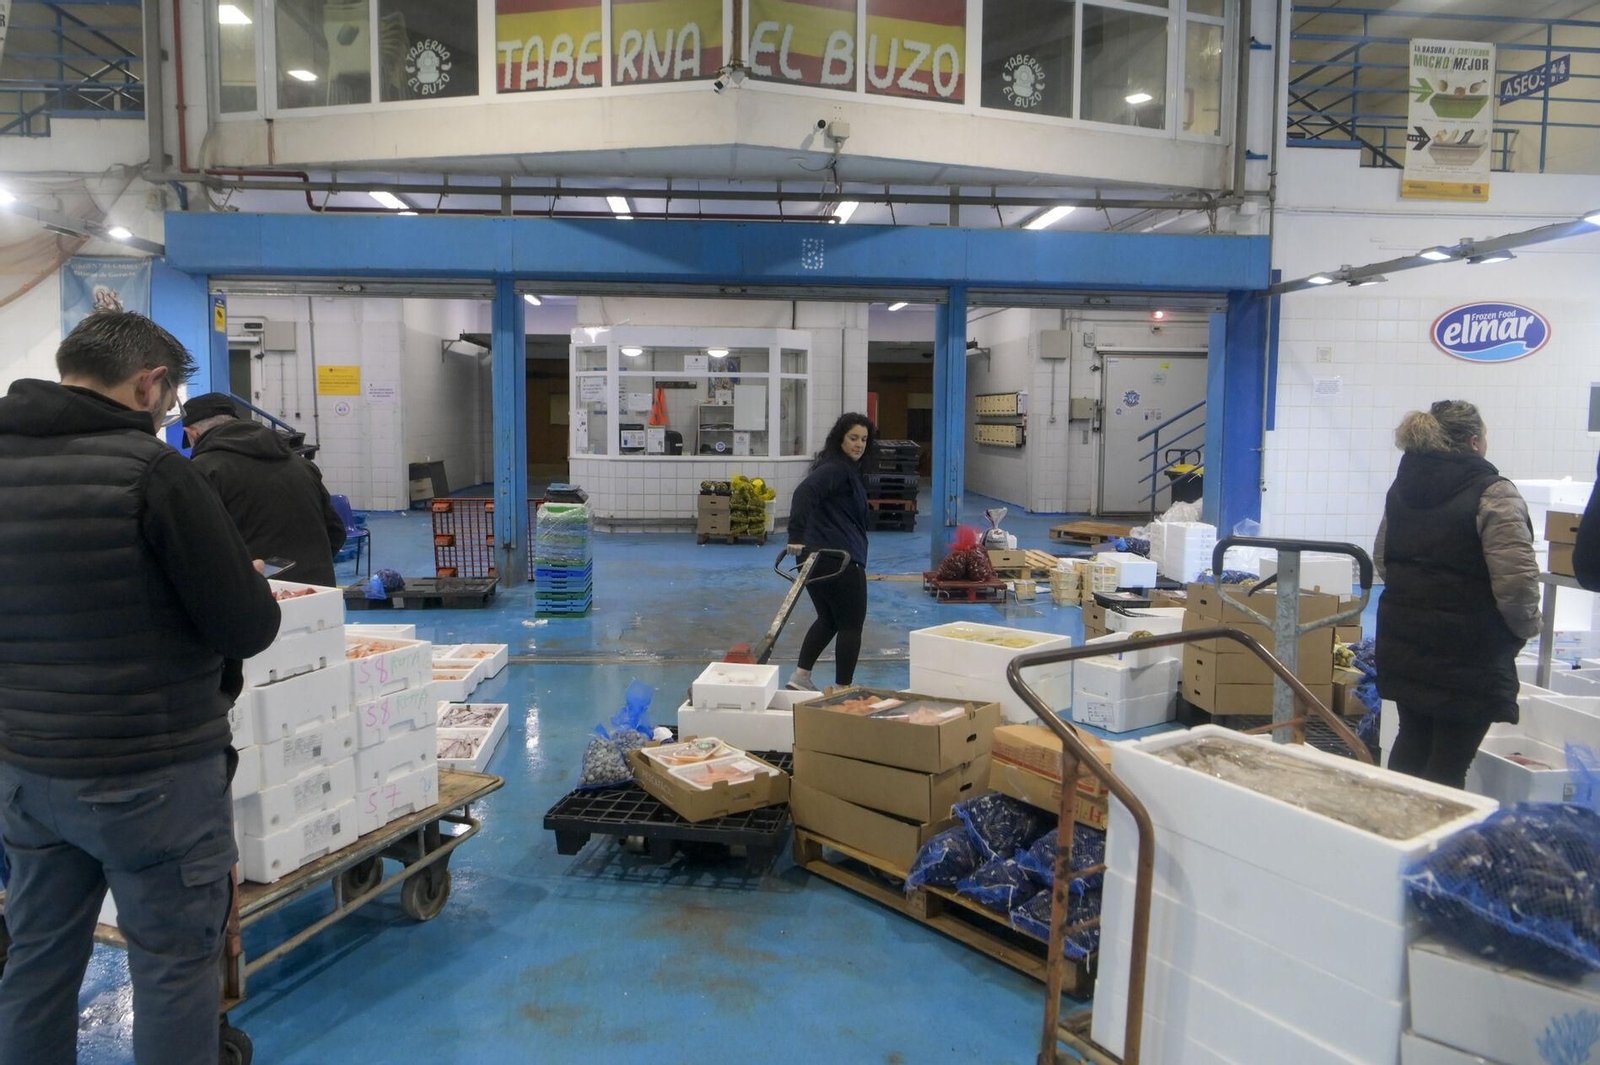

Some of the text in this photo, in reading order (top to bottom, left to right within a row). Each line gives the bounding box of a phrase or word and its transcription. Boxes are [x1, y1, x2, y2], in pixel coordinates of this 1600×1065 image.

[406, 39, 450, 61] TABERNA
[498, 21, 960, 97] TABERNA EL BUZO
[1004, 54, 1046, 80] TABERNA
[1413, 54, 1489, 71] MUCHO MEJOR
[408, 73, 450, 95] EL BUZO
[1003, 86, 1042, 108] EL BUZO
[1471, 310, 1517, 322] Frozen Food
[1444, 314, 1534, 346] elmar
